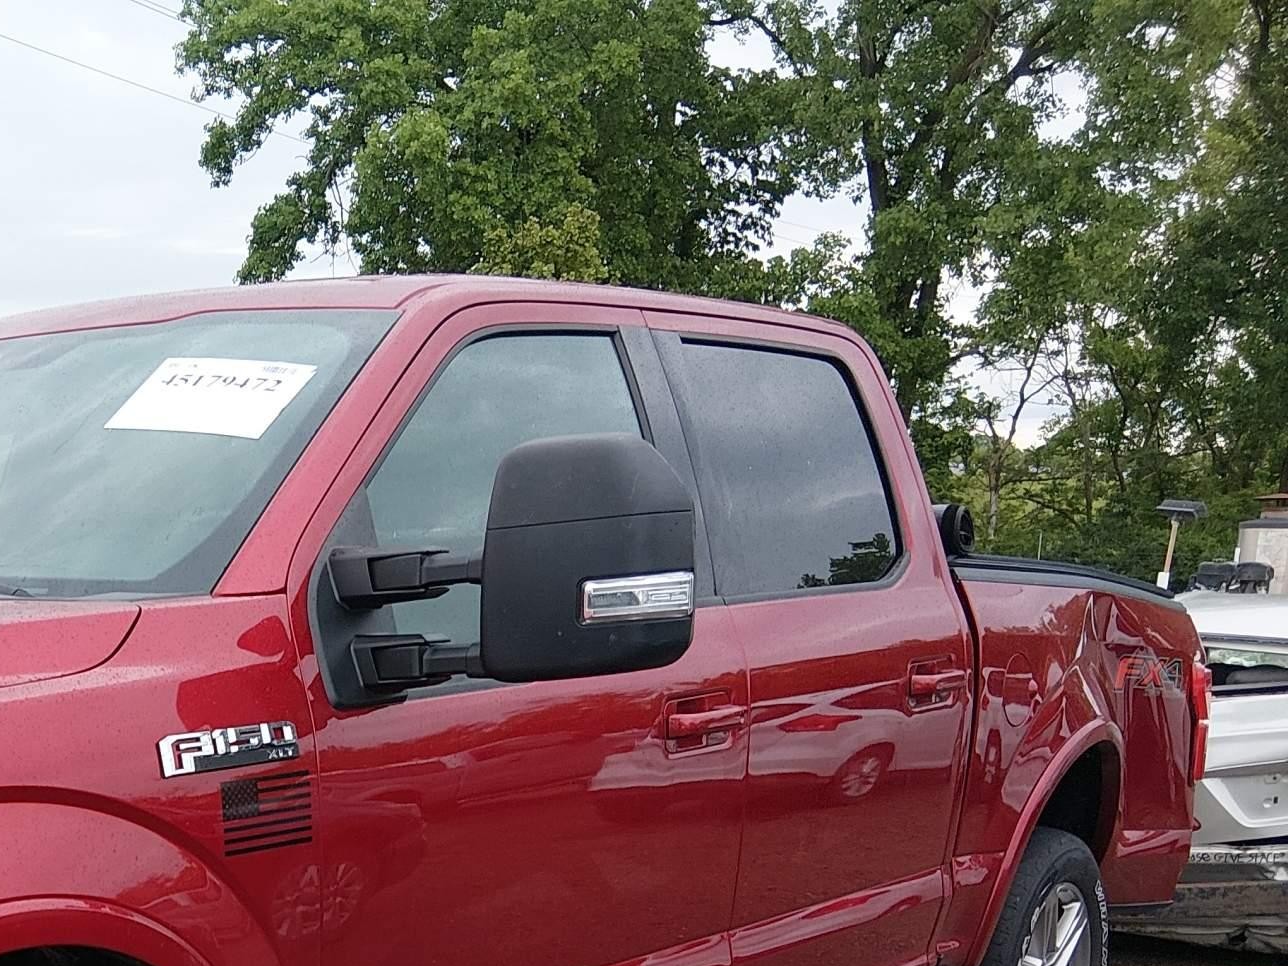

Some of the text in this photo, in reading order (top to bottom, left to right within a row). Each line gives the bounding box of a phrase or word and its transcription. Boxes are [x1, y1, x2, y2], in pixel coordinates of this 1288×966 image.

[161, 373, 283, 392] 45179472
[1112, 654, 1183, 692] FX4
[266, 747, 294, 760] XLT
